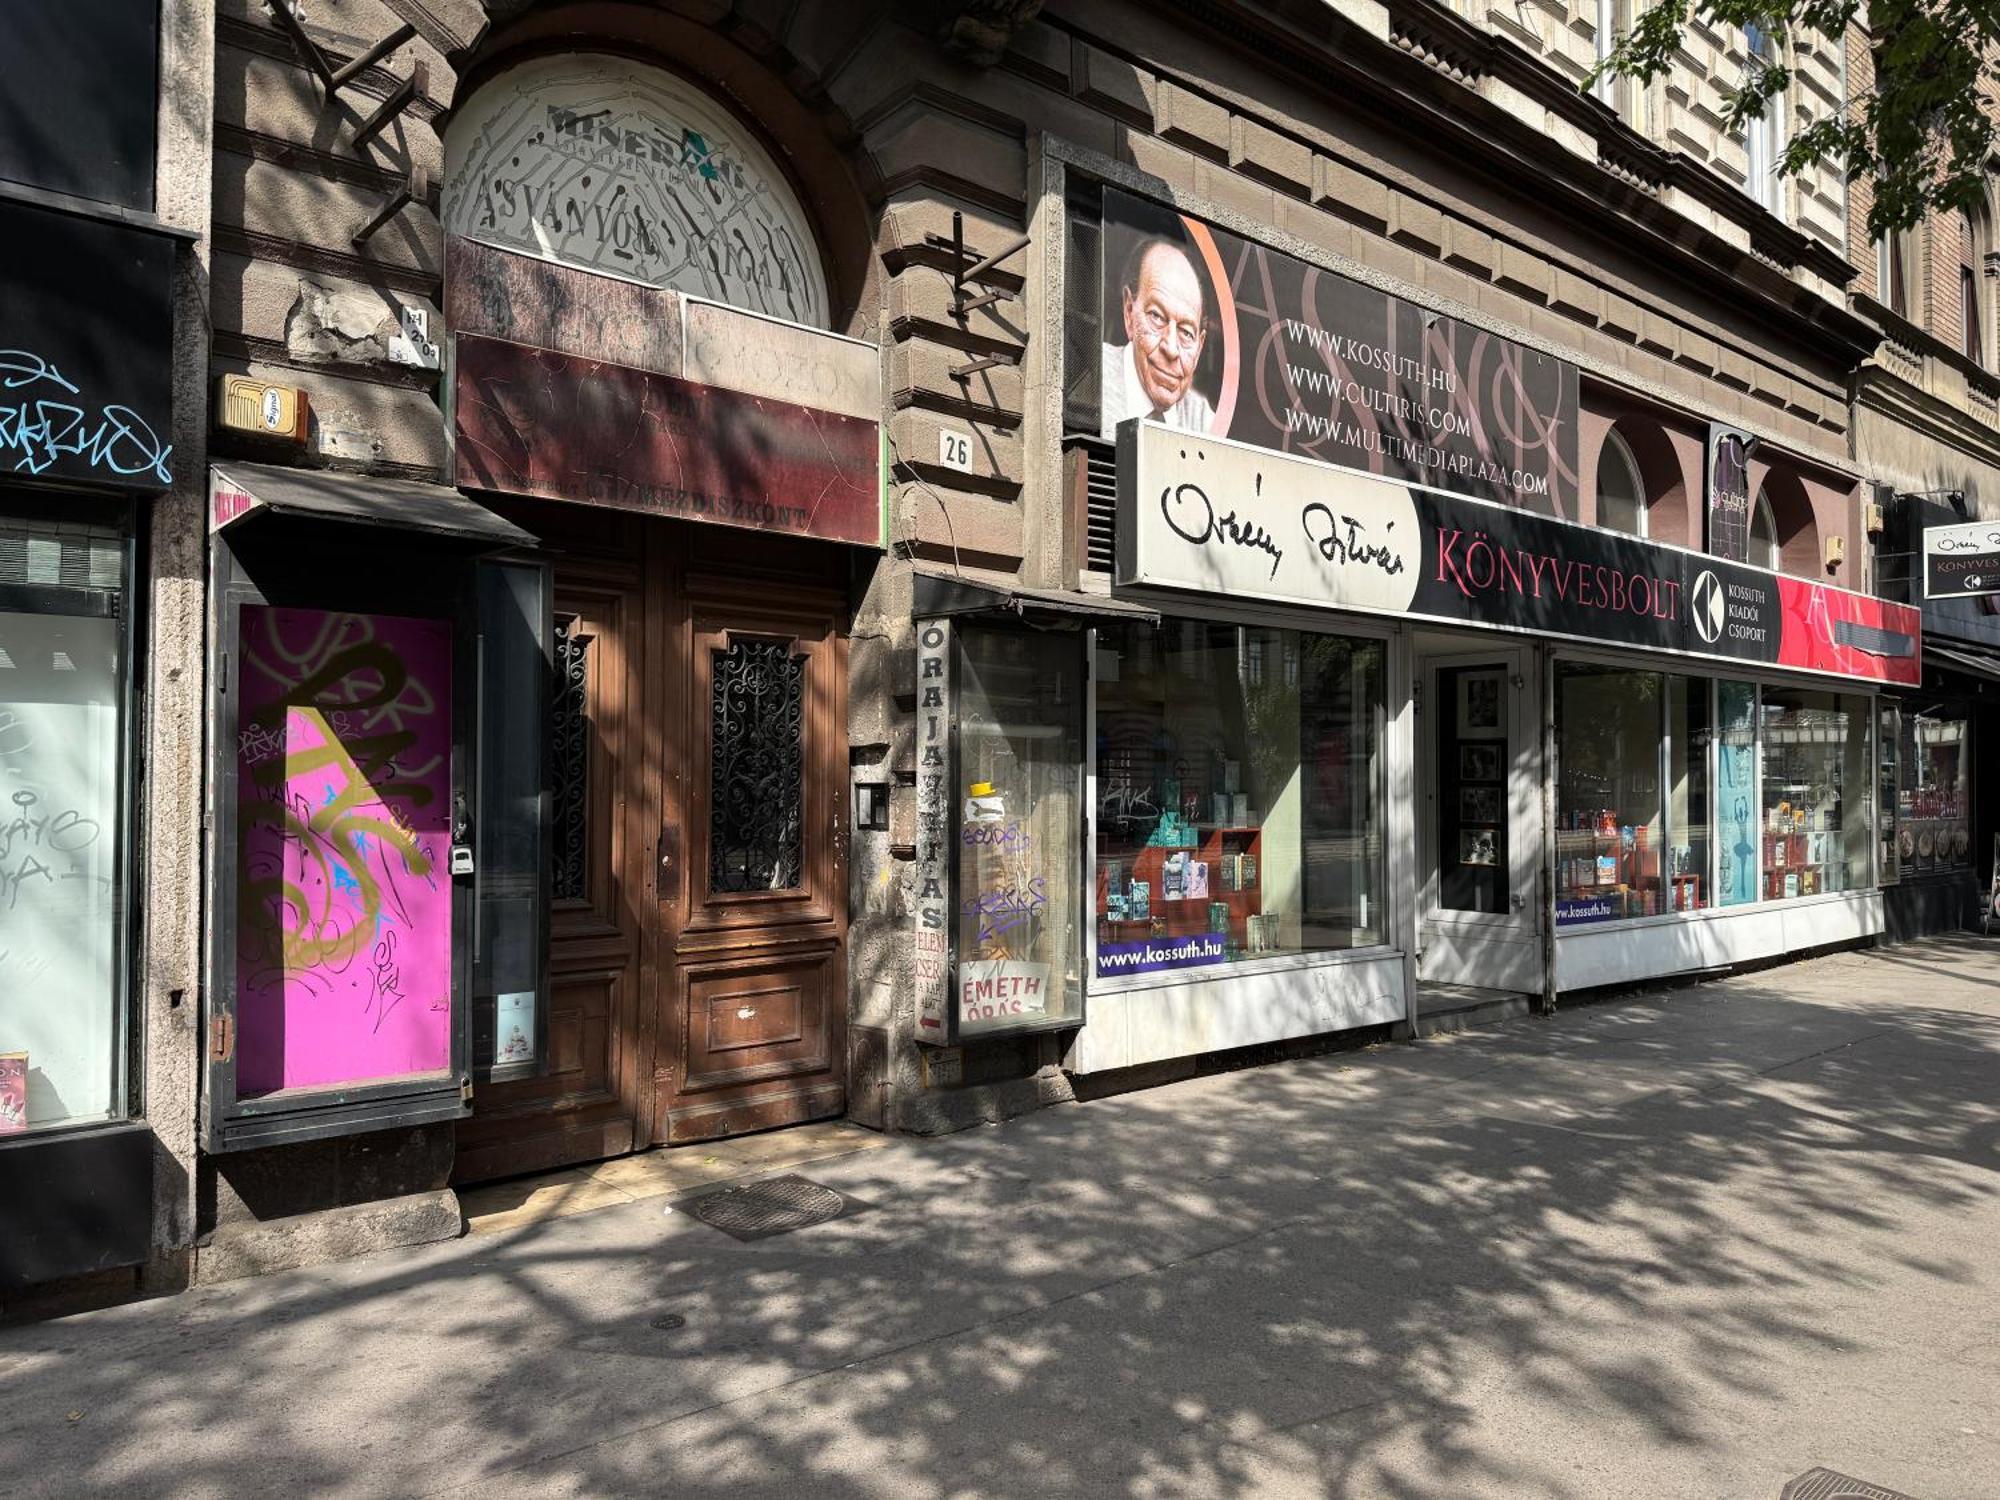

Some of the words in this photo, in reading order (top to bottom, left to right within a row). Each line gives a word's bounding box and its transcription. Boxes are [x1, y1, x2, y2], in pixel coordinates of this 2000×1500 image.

[1285, 318, 1457, 394] WWW.KOSSUTH.HU
[265, 392, 279, 425] Signal
[1285, 363, 1471, 437] WWW.CULTIRIS.COM
[946, 435, 967, 465] 26
[1284, 407, 1549, 496] WWW.MULTIMEDIAPLAZA.COM
[1434, 526, 1681, 622] KÖNYVESBOLT
[1728, 583, 1766, 605] KOSSUTH
[1728, 625, 1768, 643] CSOPORT
[1099, 939, 1222, 968] www.kossuth.hu
